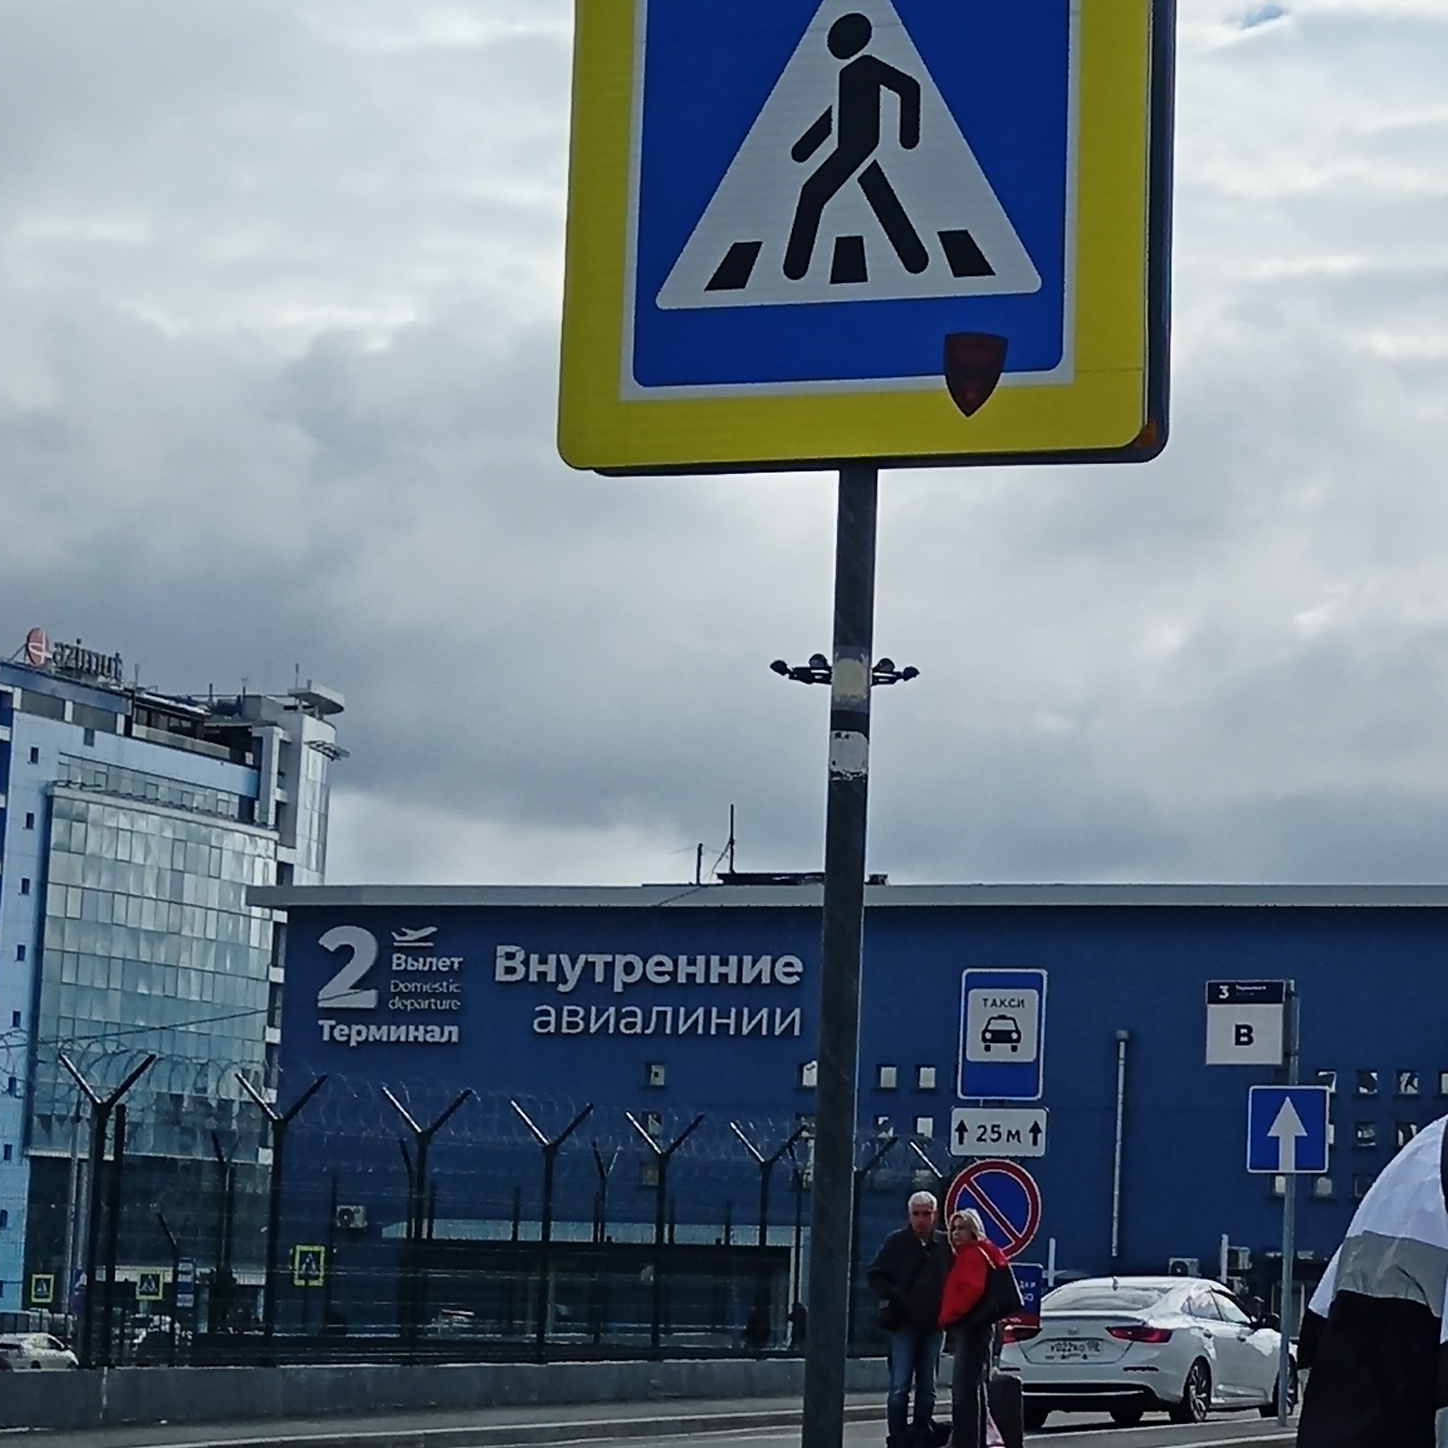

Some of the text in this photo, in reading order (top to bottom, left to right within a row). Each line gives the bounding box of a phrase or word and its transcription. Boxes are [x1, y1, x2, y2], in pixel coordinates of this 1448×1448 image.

[317, 925, 379, 1009] 2
[391, 952, 463, 972] Вылет
[494, 944, 804, 993] Внутренние
[390, 979, 461, 993] Domestic
[1218, 985, 1230, 999] 3
[388, 997, 461, 1013] departure
[982, 998, 1026, 1009] ТАКСИ
[532, 1004, 802, 1036] авиалинии
[317, 1019, 460, 1047] Терминал
